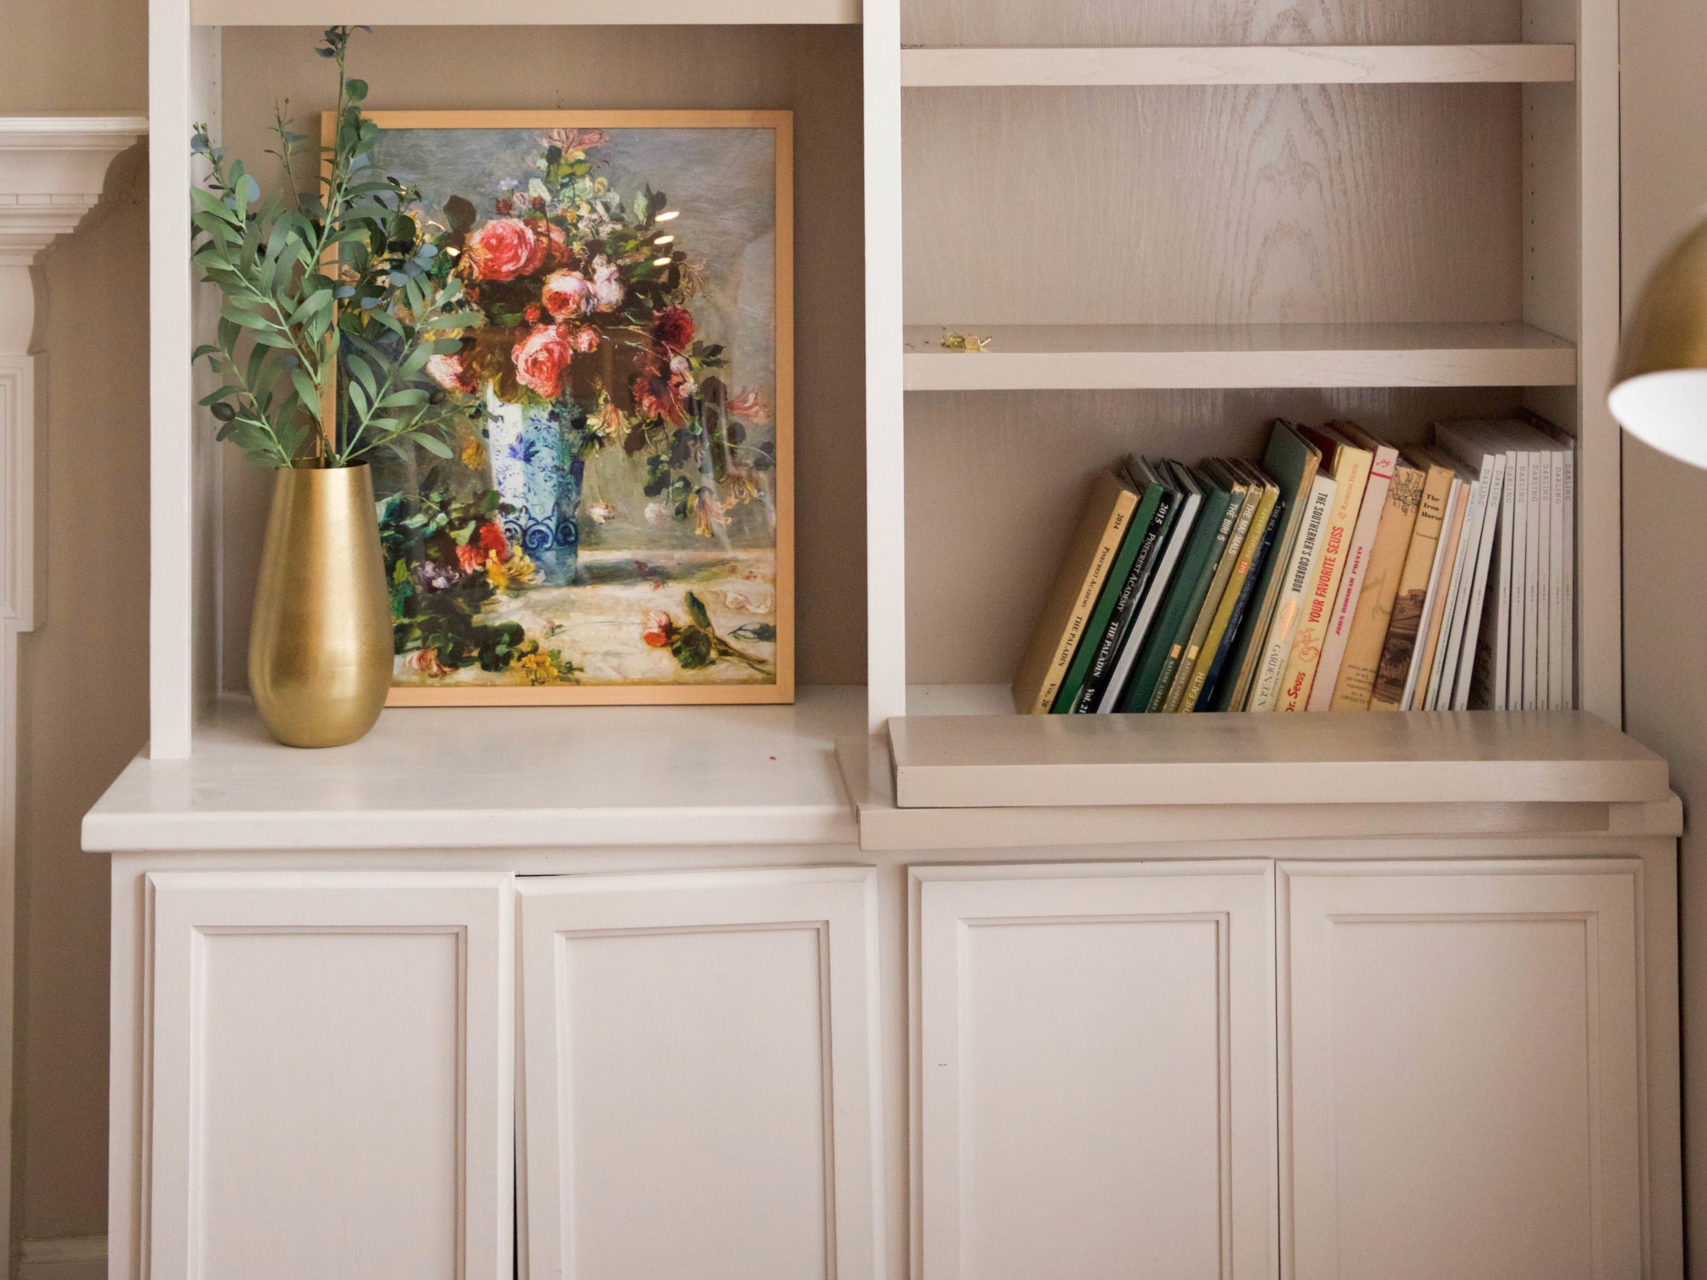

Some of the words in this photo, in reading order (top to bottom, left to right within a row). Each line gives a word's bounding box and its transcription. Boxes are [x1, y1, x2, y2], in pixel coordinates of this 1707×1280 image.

[1226, 503, 1239, 518] THE
[1243, 504, 1255, 520] THE
[1316, 492, 1328, 505] THE
[1423, 502, 1440, 512] Iron
[1426, 494, 1440, 502] The
[1113, 513, 1125, 530] 2014
[1155, 502, 1169, 524] 2015
[1301, 505, 1325, 556] SOUTHERNER'S
[1326, 525, 1345, 555] SEUSS
[1291, 555, 1309, 593] COOKBOOK
[1315, 555, 1337, 598] FAVORITE
[1335, 615, 1345, 636] JOHN
[1352, 546, 1363, 574] PRINTS
[1071, 615, 1083, 629] THE
[1308, 594, 1325, 623] YOUR
[1106, 621, 1120, 637] THE
[1058, 630, 1076, 667] PALADIN
[1093, 637, 1112, 678] PALADIN
[1263, 644, 1281, 682] GARDEN
[1182, 699, 1194, 713] THE
[1189, 671, 1205, 699] EARTH
[1257, 686, 1270, 707] GUN
[1287, 671, 1306, 700] Seuss
